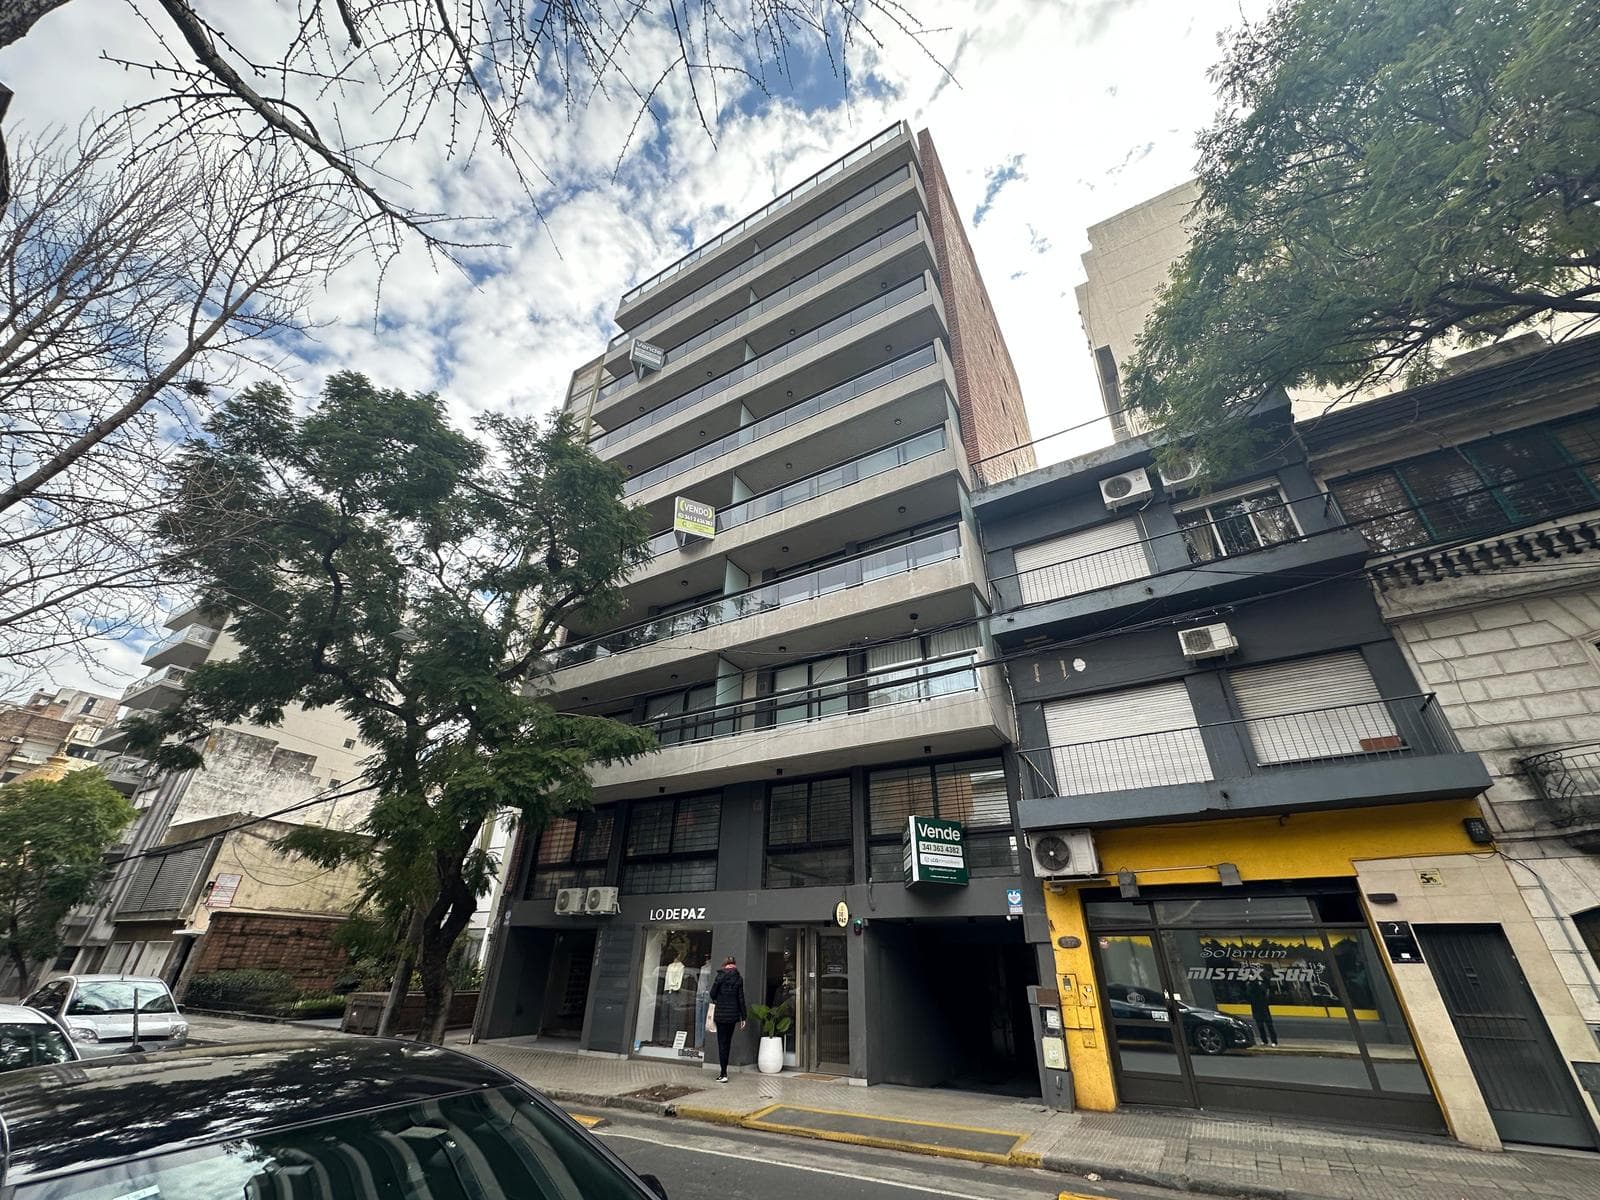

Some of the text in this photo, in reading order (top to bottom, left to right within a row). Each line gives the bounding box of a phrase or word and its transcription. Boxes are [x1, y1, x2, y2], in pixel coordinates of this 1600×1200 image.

[684, 503, 709, 517] VENDO
[917, 823, 961, 841] Vende
[921, 843, 932, 851] 341
[650, 907, 706, 920] LO DE PAZ
[1200, 946, 1288, 959] Solarium
